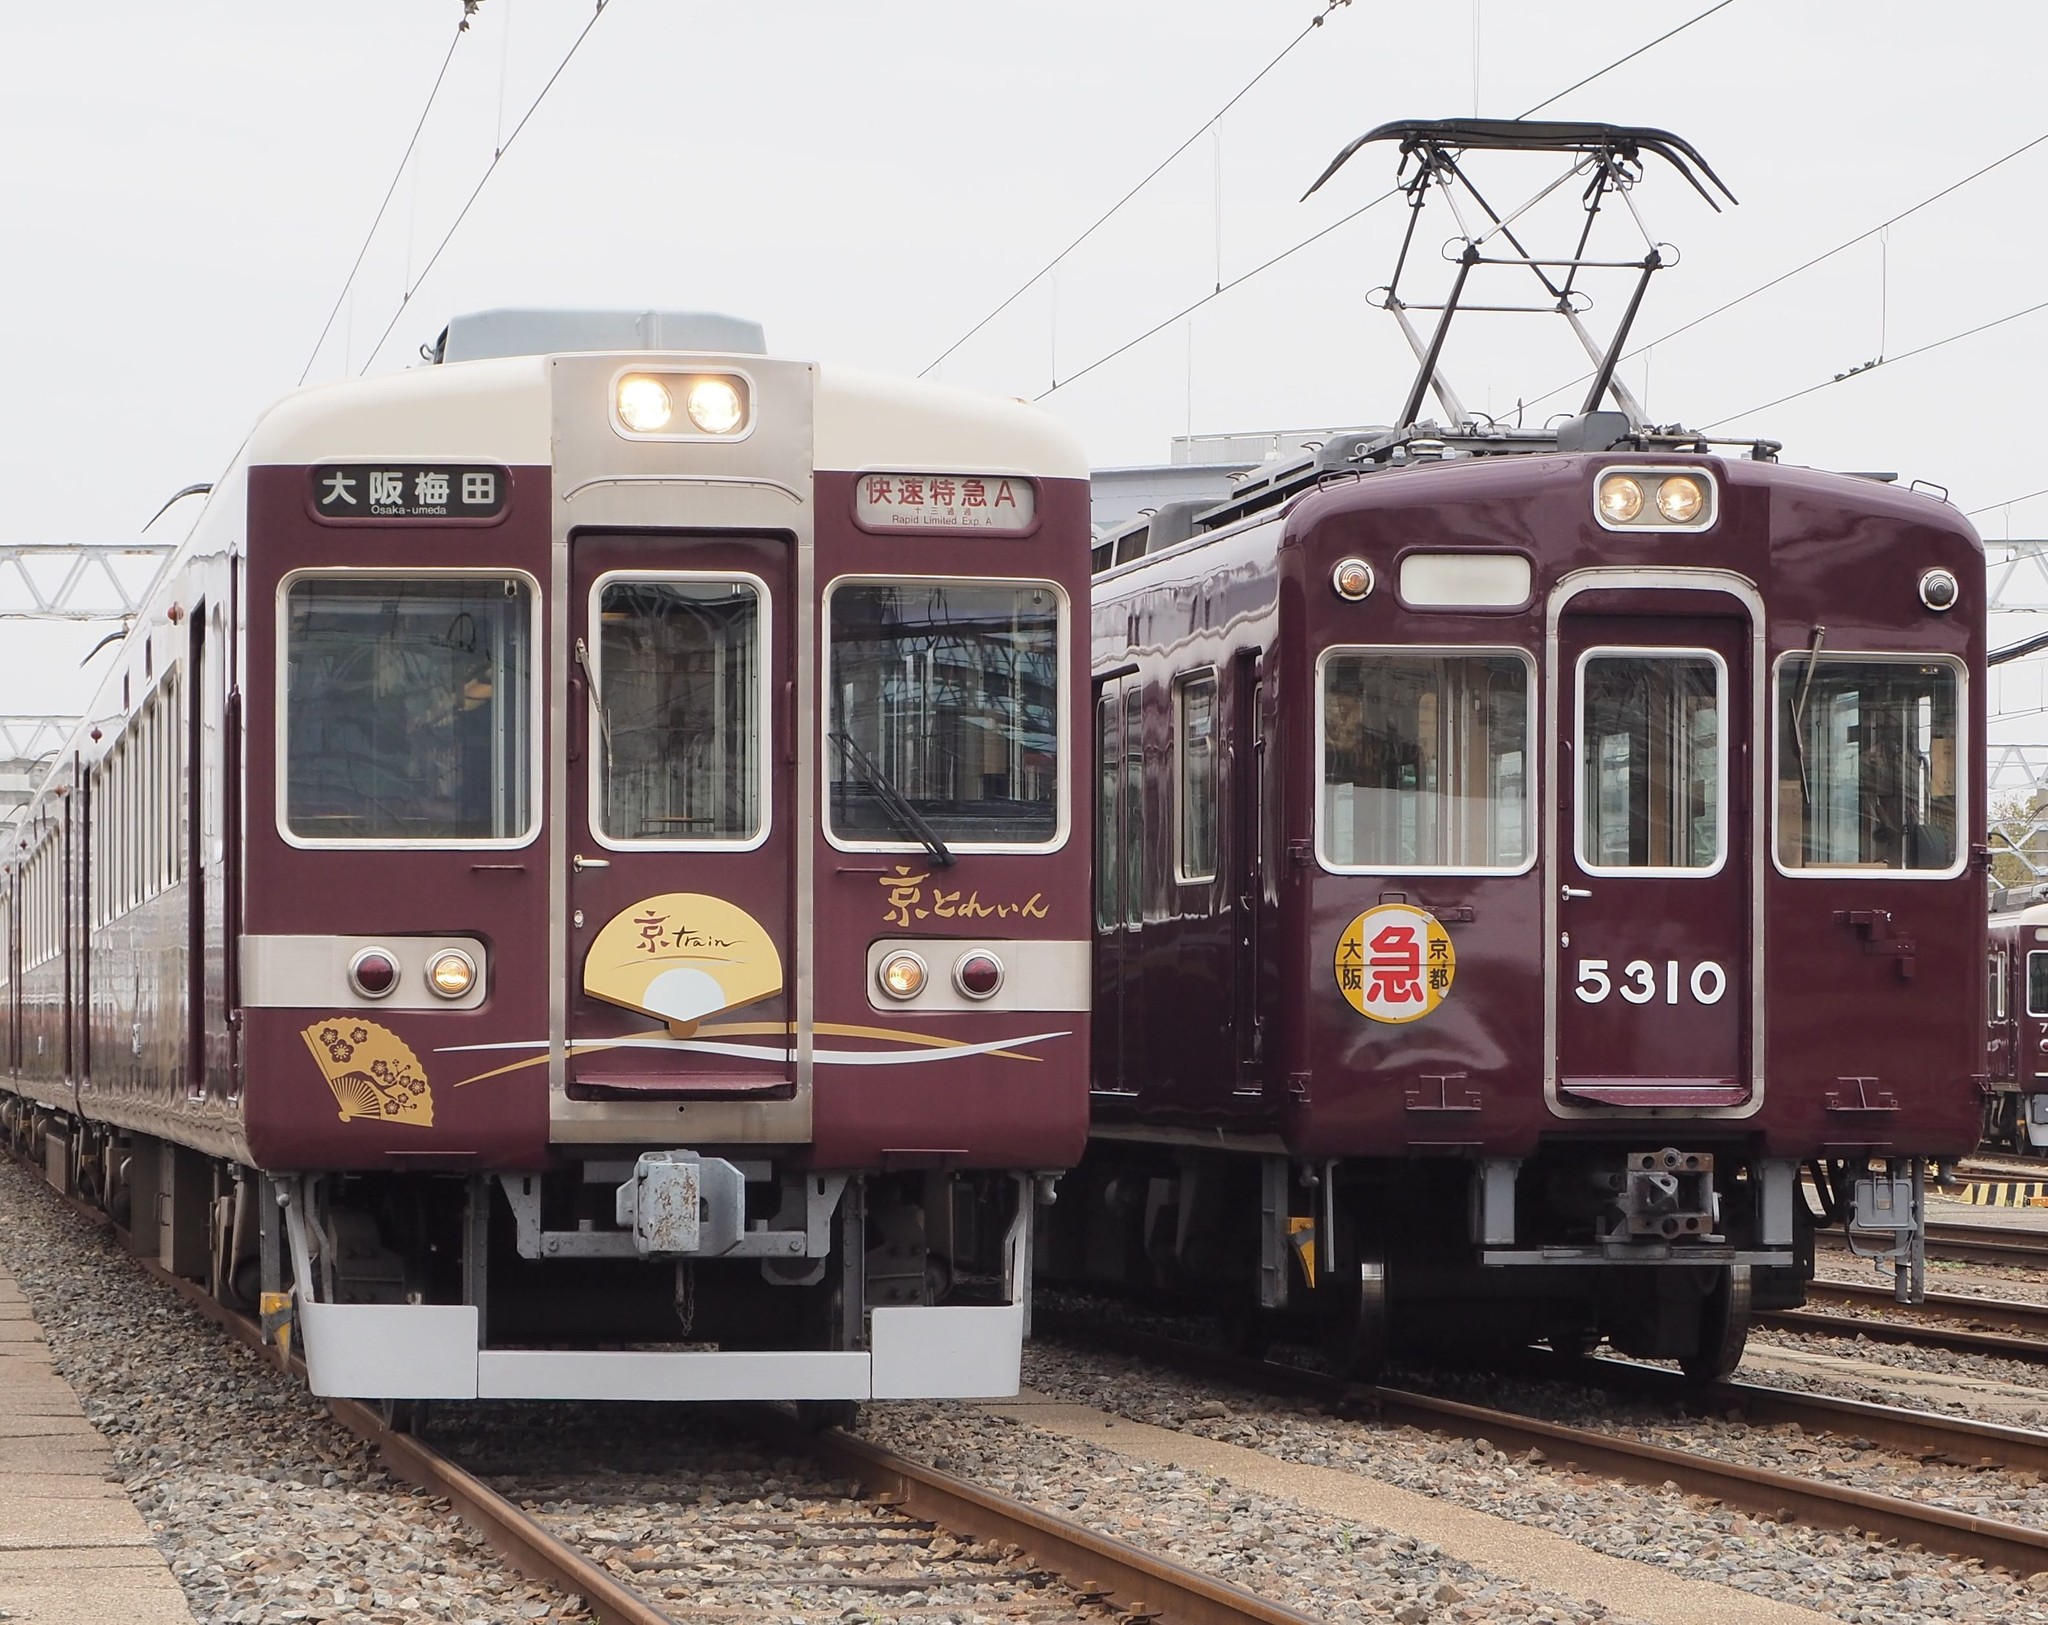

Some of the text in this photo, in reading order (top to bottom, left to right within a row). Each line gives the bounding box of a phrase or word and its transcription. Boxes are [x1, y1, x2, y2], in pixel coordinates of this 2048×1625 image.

[322, 471, 495, 505] 大阪梅田
[371, 504, 447, 516] Osaka-umeda
[865, 477, 1016, 508] 快速特急A
[892, 514, 993, 527] Rapid Limited Exp. A
[879, 866, 1050, 927] 京とれいん
[1342, 938, 1362, 990] 大阪
[1366, 925, 1425, 1003] 急
[1428, 938, 1449, 990] 京都
[1575, 959, 1727, 1005] 5310
